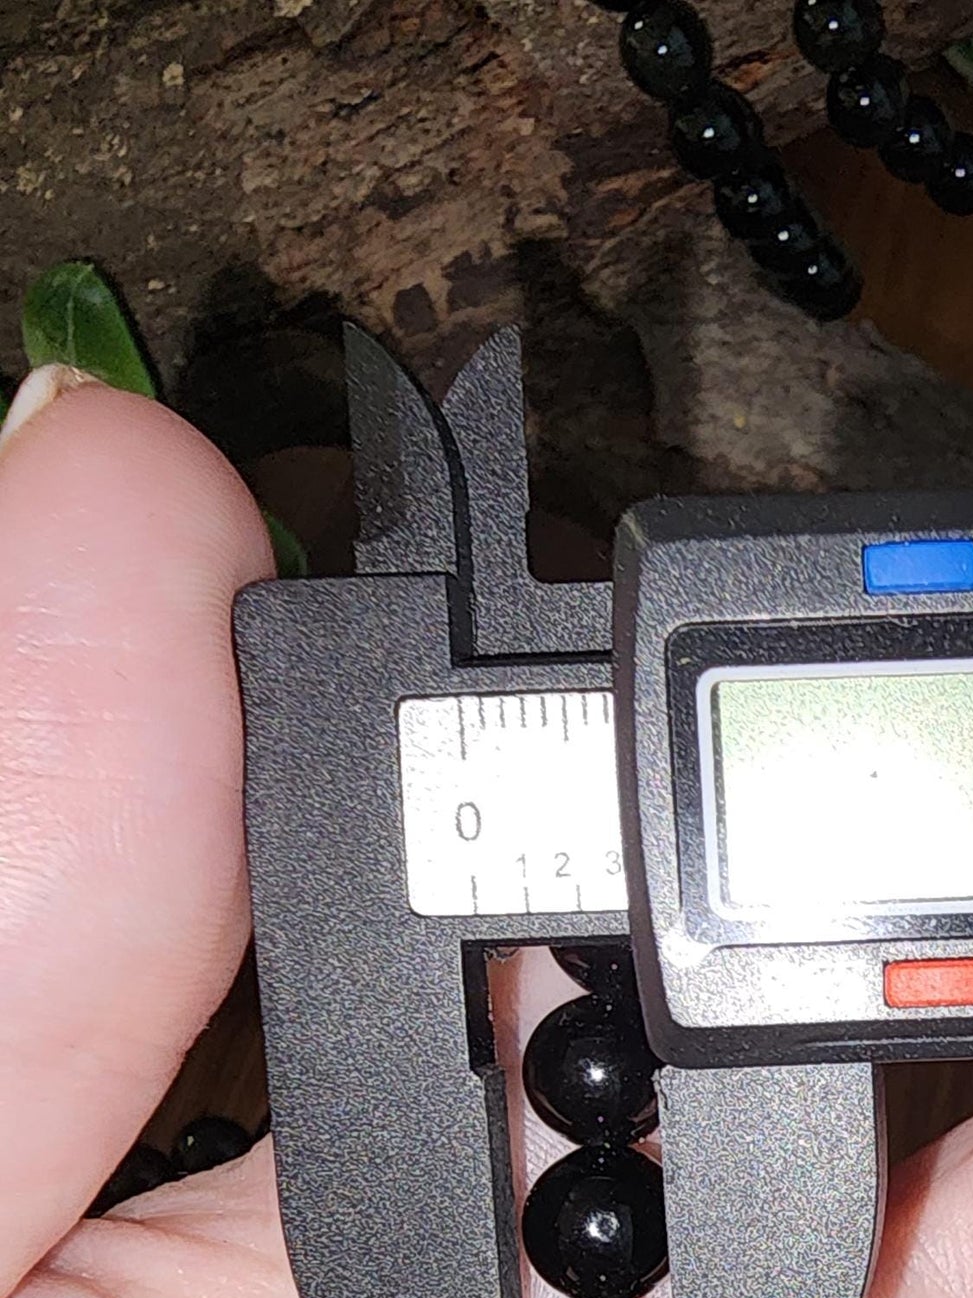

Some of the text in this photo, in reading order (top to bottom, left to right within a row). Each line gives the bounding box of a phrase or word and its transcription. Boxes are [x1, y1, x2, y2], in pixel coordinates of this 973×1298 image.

[455, 801, 481, 841] 0
[515, 850, 622, 878] 1 2 3
